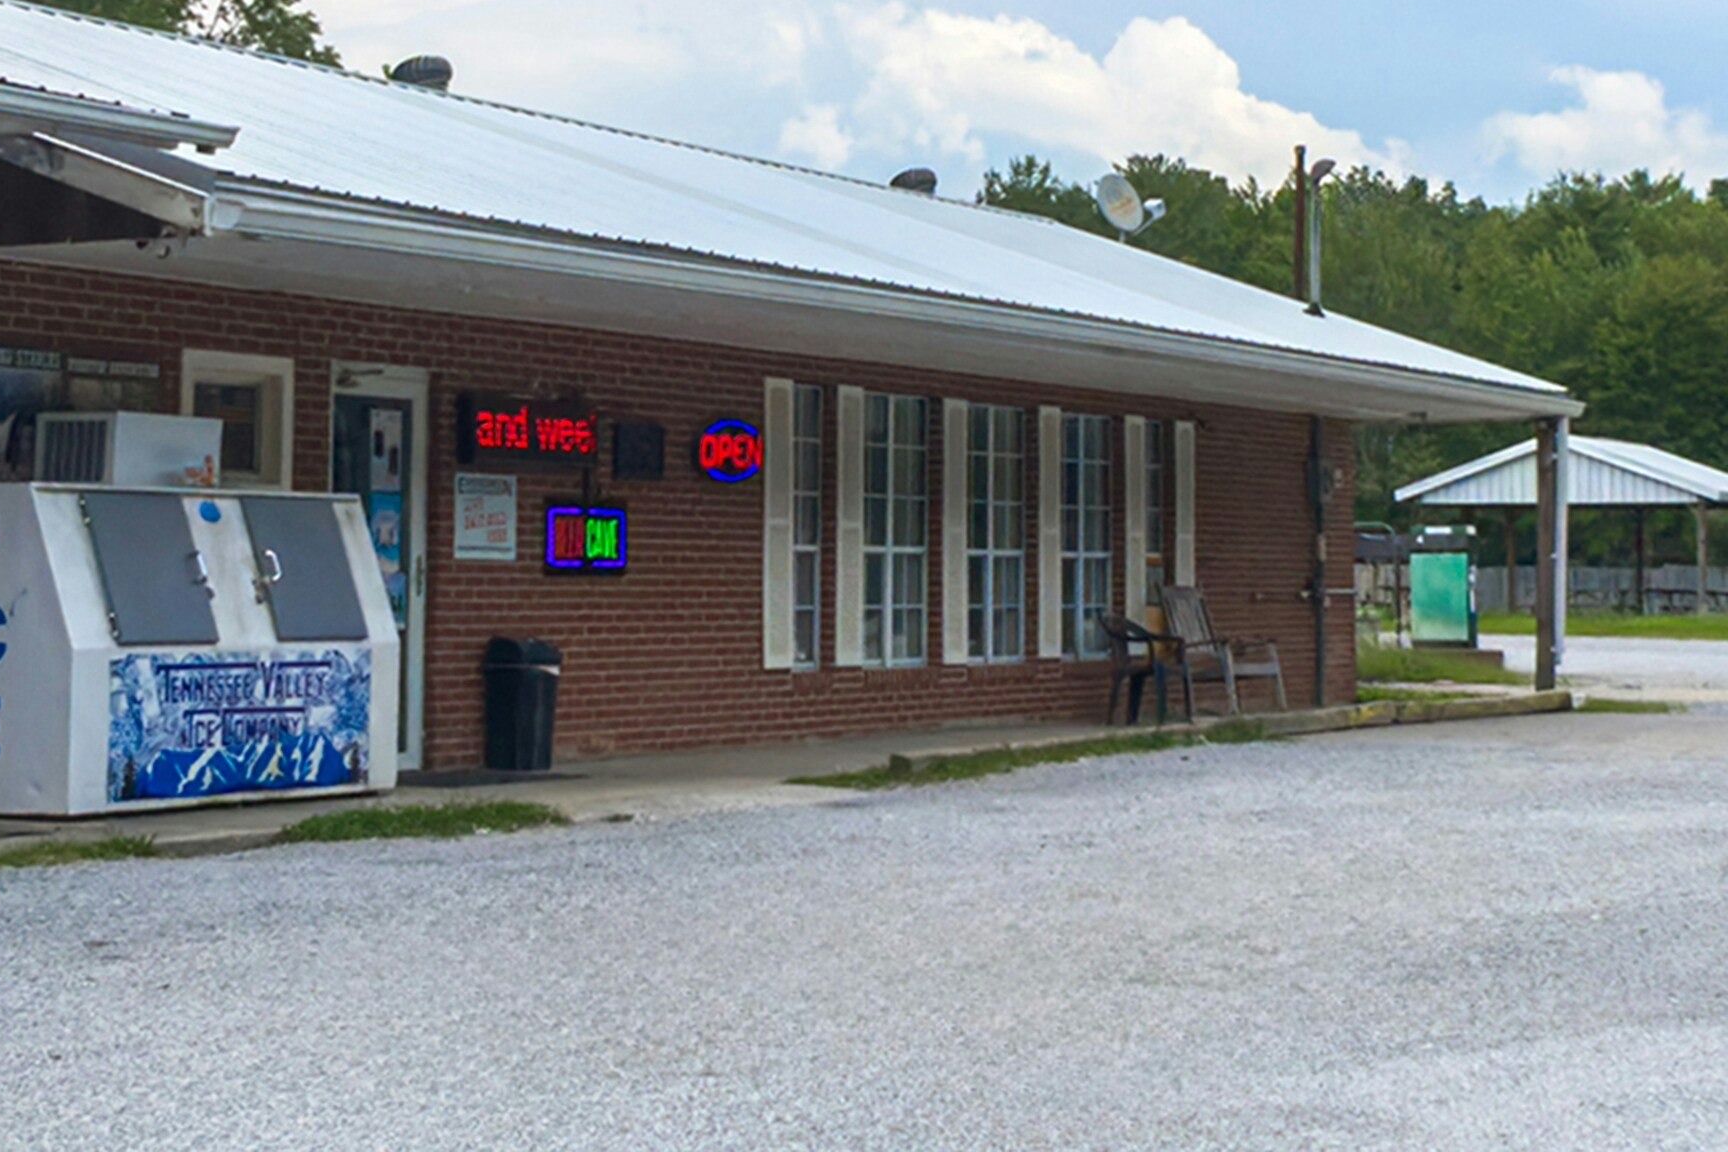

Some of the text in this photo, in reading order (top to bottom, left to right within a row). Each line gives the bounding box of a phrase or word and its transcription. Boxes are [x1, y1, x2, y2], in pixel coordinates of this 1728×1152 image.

[477, 407, 596, 454] and wee
[699, 433, 764, 469] OPEN
[156, 661, 332, 703] TENNESSEE VALLEY
